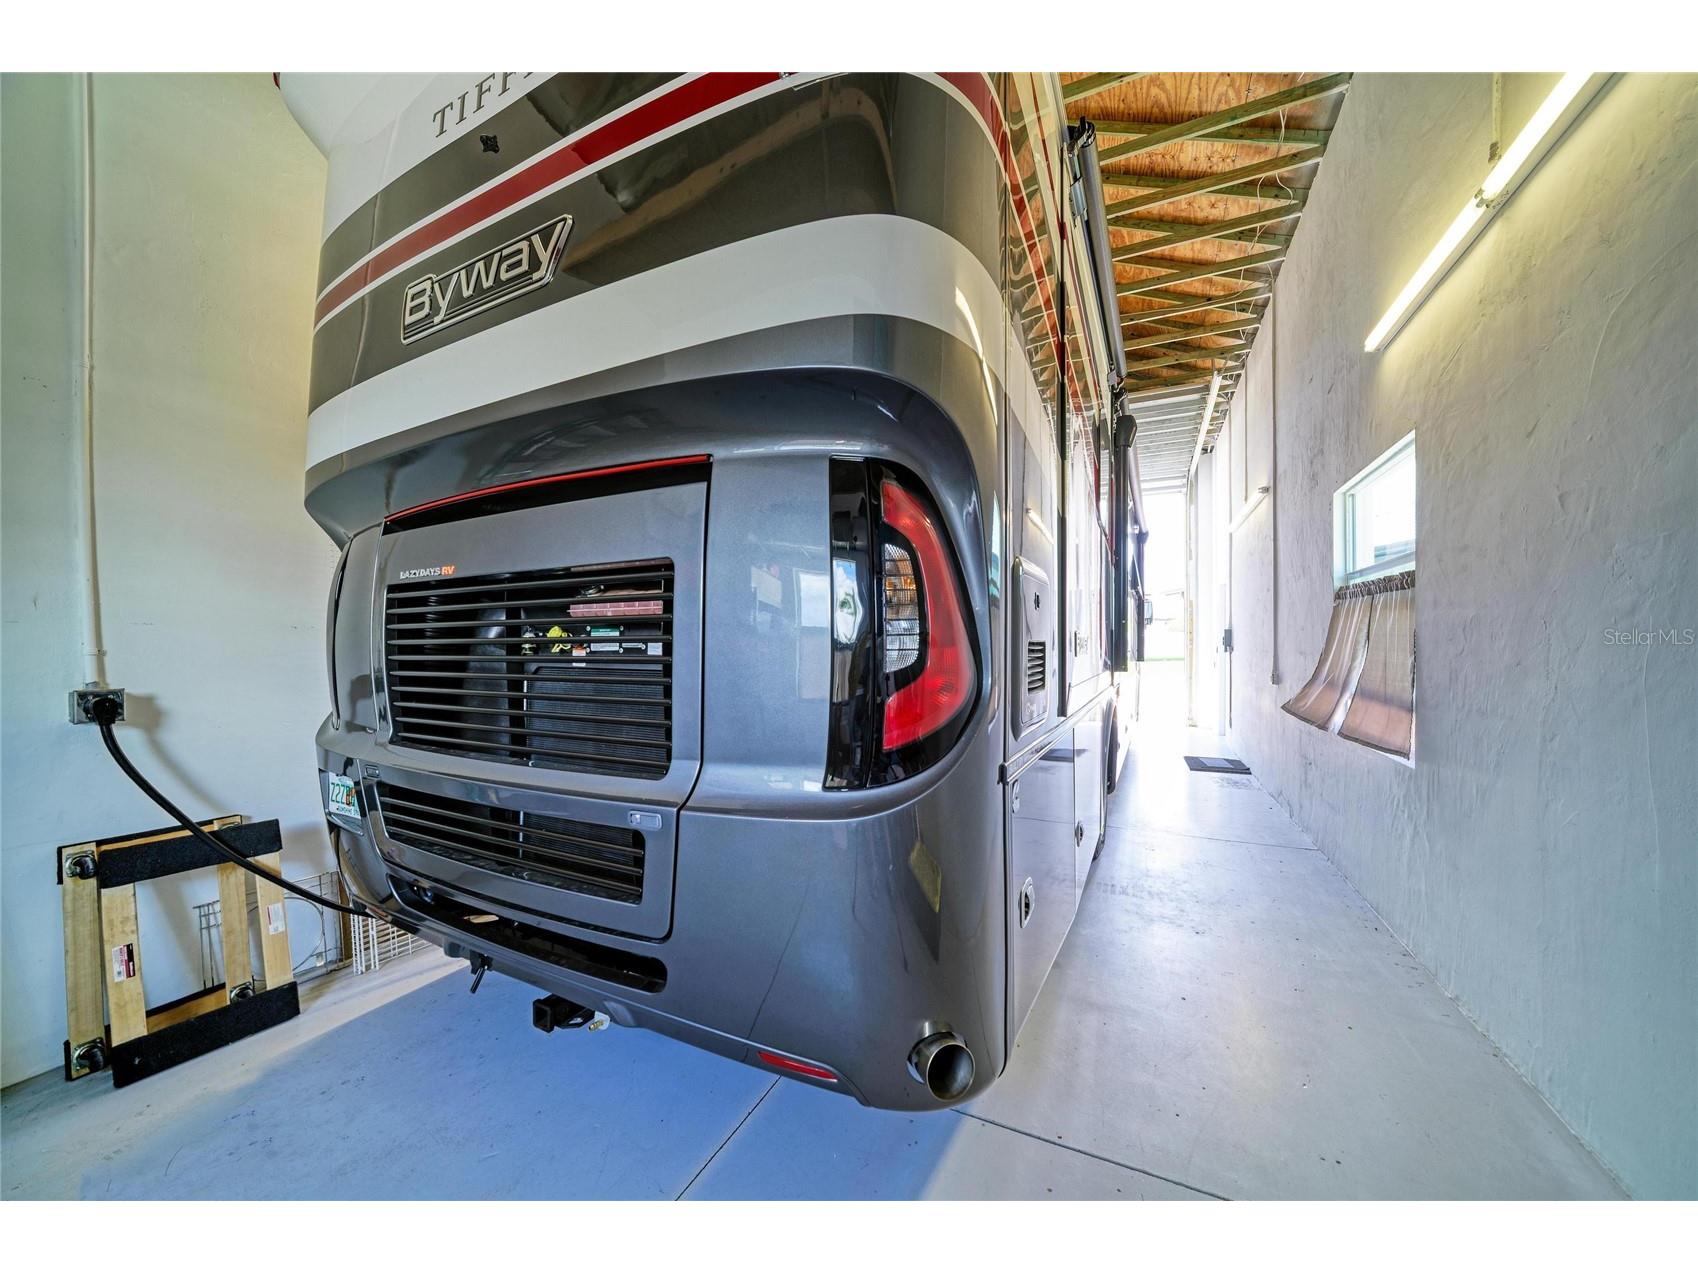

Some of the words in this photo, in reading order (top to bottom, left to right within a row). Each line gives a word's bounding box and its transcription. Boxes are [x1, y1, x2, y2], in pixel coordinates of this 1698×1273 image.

[433, 72, 534, 138] TIFF
[404, 220, 565, 325] Byway
[400, 567, 441, 580] LAZYDAYS
[441, 565, 455, 576] RV
